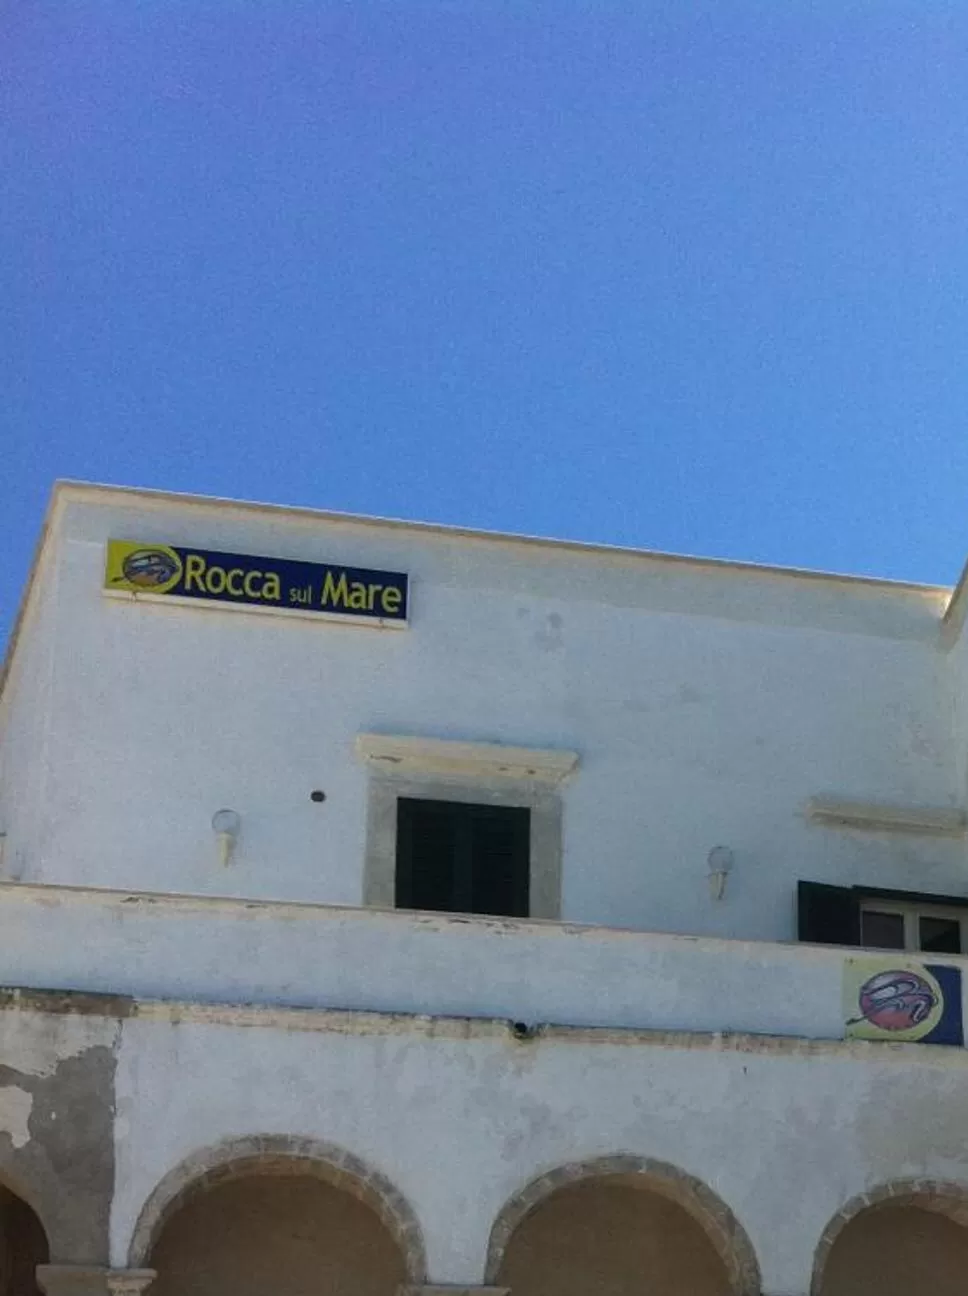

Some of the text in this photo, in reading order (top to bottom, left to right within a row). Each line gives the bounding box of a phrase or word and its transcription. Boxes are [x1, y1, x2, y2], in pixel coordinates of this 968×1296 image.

[184, 554, 402, 613] Rocca sul Mare
